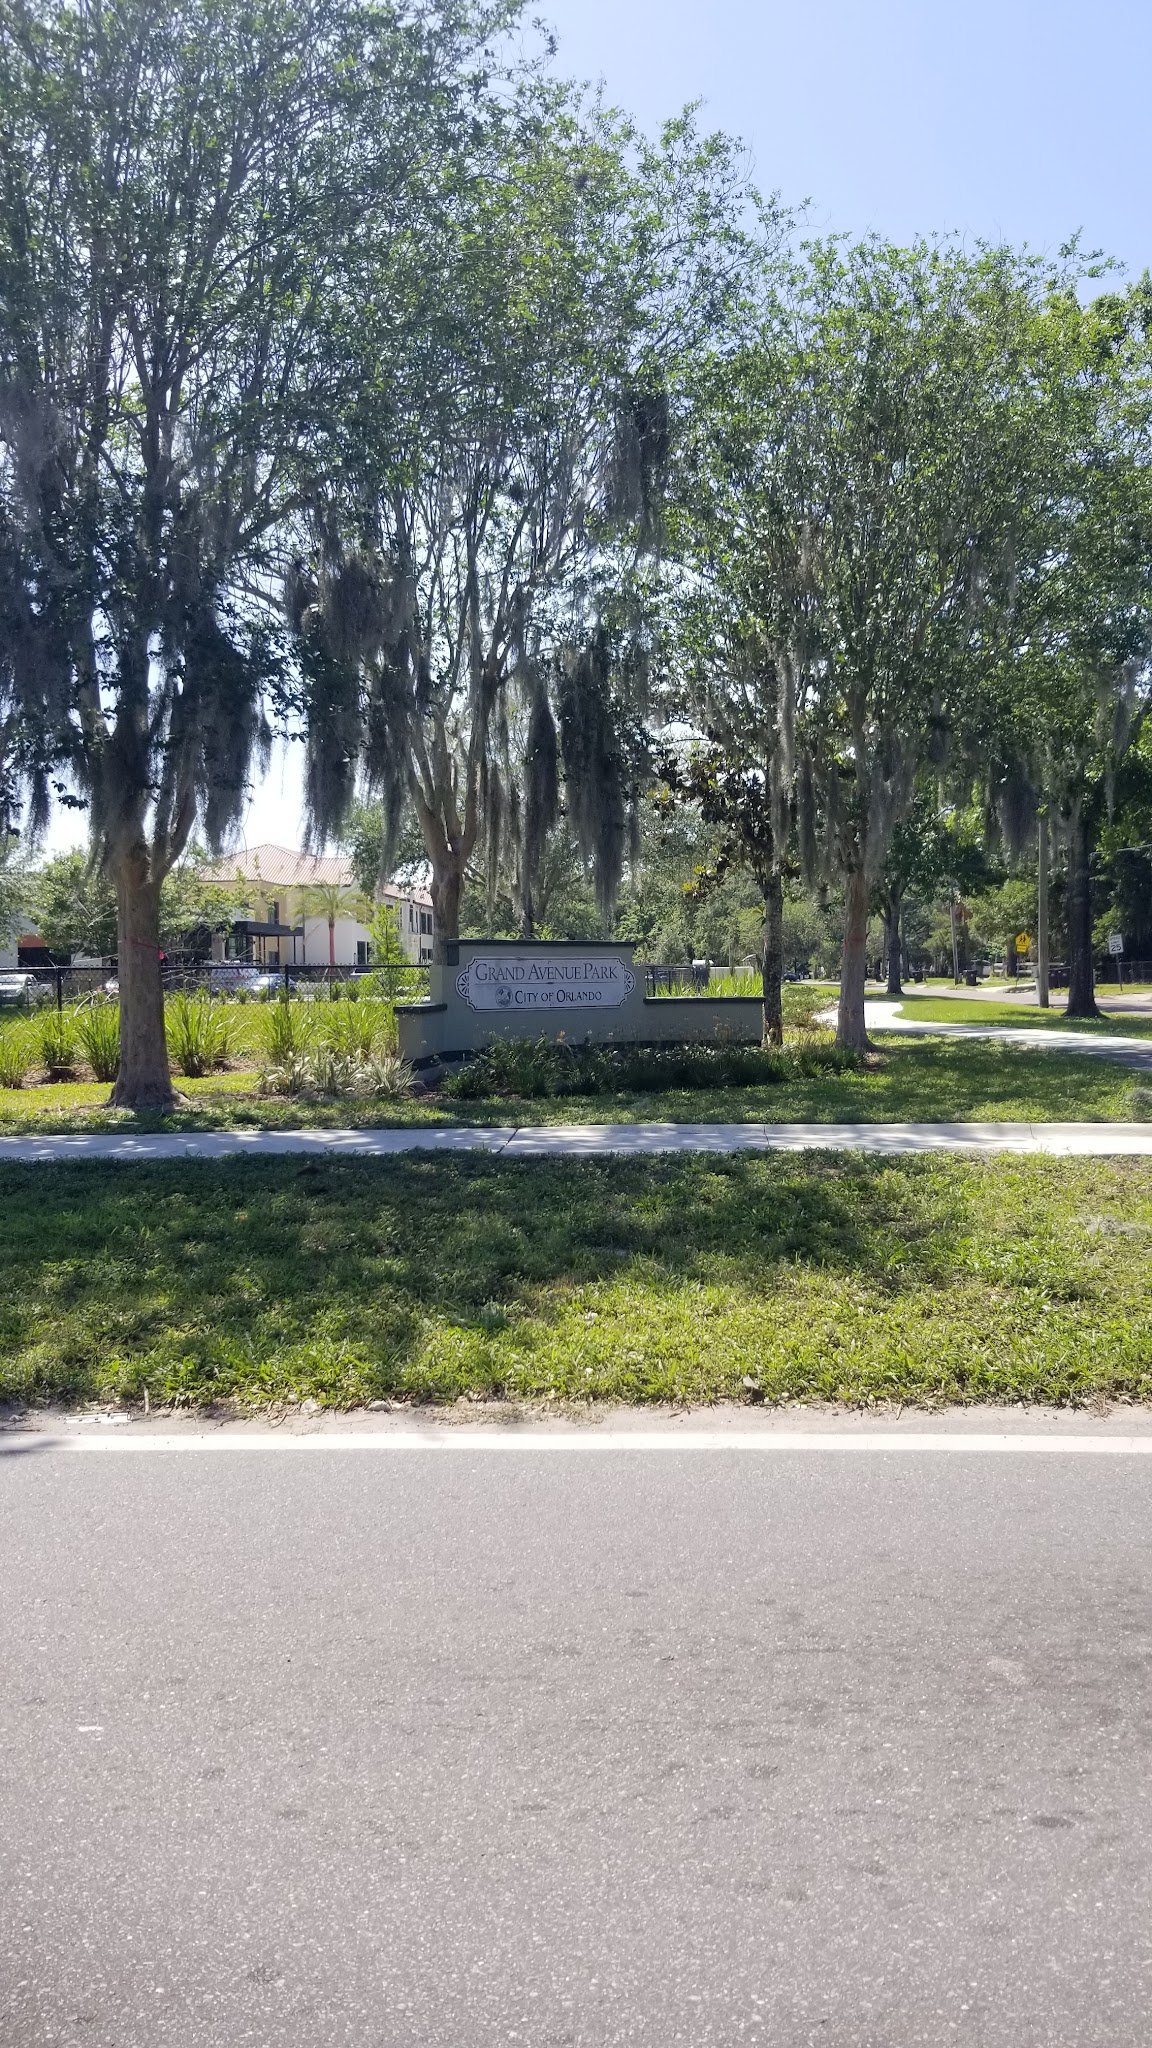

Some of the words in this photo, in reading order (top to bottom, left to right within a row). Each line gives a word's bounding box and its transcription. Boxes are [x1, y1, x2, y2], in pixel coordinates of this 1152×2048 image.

[1110, 943, 1122, 952] 25
[475, 963, 525, 981] GRAND
[528, 963, 581, 980] AVENUE
[583, 963, 618, 979] PARK
[515, 991, 538, 1004] CITY
[541, 992, 554, 1002] OF
[556, 990, 602, 1003] ORLANDO
